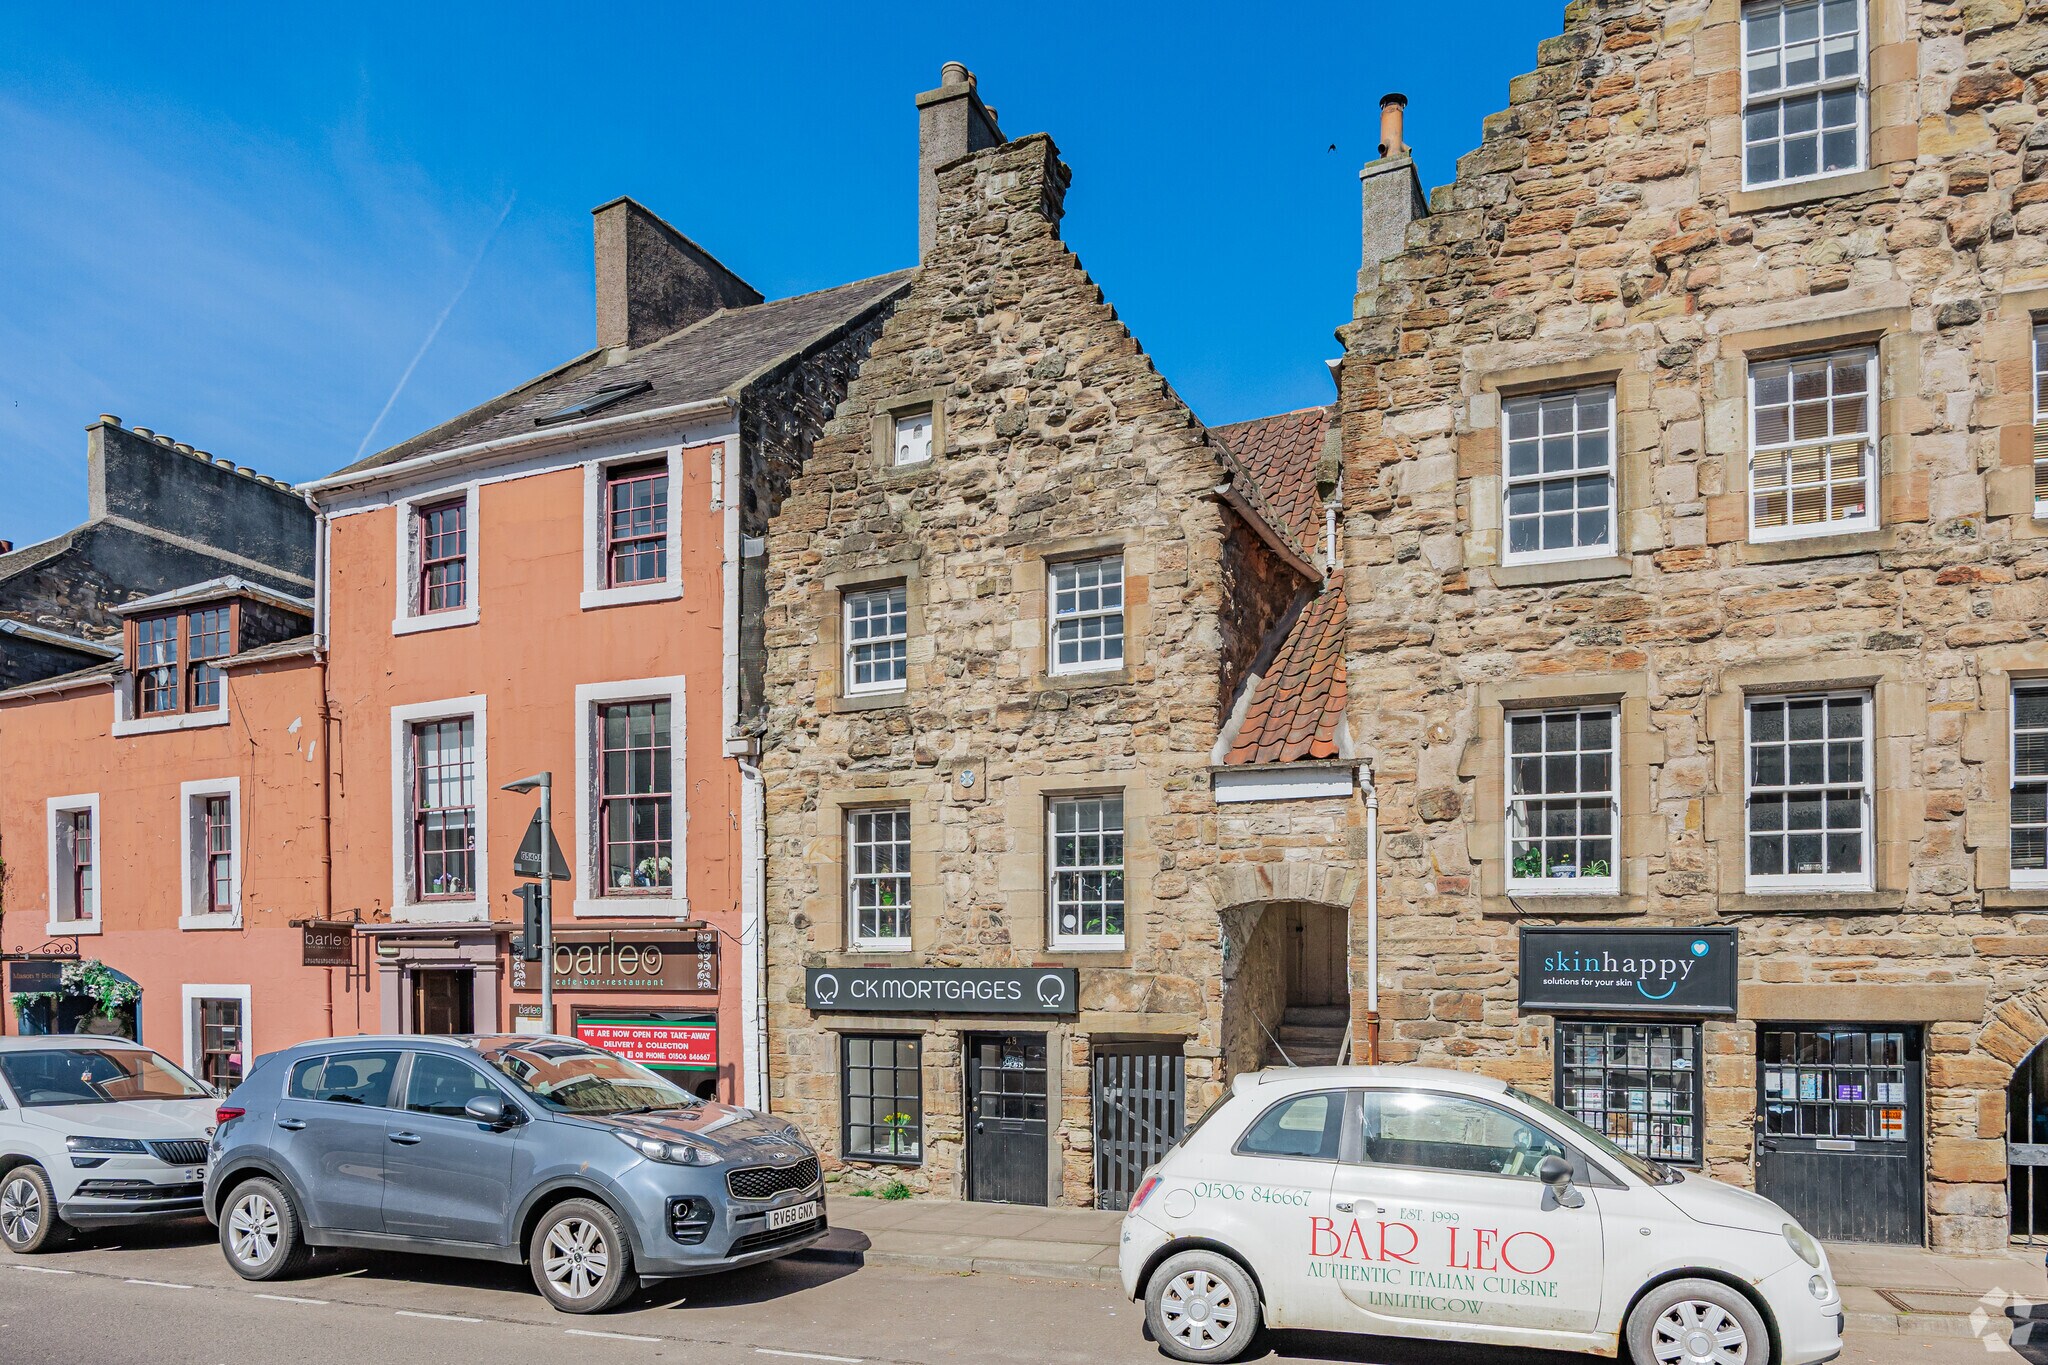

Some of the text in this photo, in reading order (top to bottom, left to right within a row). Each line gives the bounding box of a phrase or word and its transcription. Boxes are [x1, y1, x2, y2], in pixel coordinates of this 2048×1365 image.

[305, 931, 351, 946] barleo
[553, 936, 663, 975] barleo
[1544, 950, 1695, 980] skinhappy
[1543, 977, 1633, 988] solutions for your skin
[584, 1029, 711, 1041] WE ARE NOW OPEN FOR TAKE-AWAY
[603, 1040, 689, 1050] DELIVERY & COLLECTION
[1005, 1036, 1017, 1045] 48
[668, 1053, 687, 1061] 01506
[688, 1053, 711, 1061] 846667
[1194, 1182, 1312, 1207] 01506 846667
[773, 1203, 814, 1227] RV68 GNX
[1400, 1208, 1460, 1224] EST. 1999
[1308, 1216, 1555, 1275] BAR LEO
[1307, 1261, 1558, 1298] AUTHENTIC ITALIAN CUISINE
[1369, 1290, 1483, 1315] LINLITHGOW
